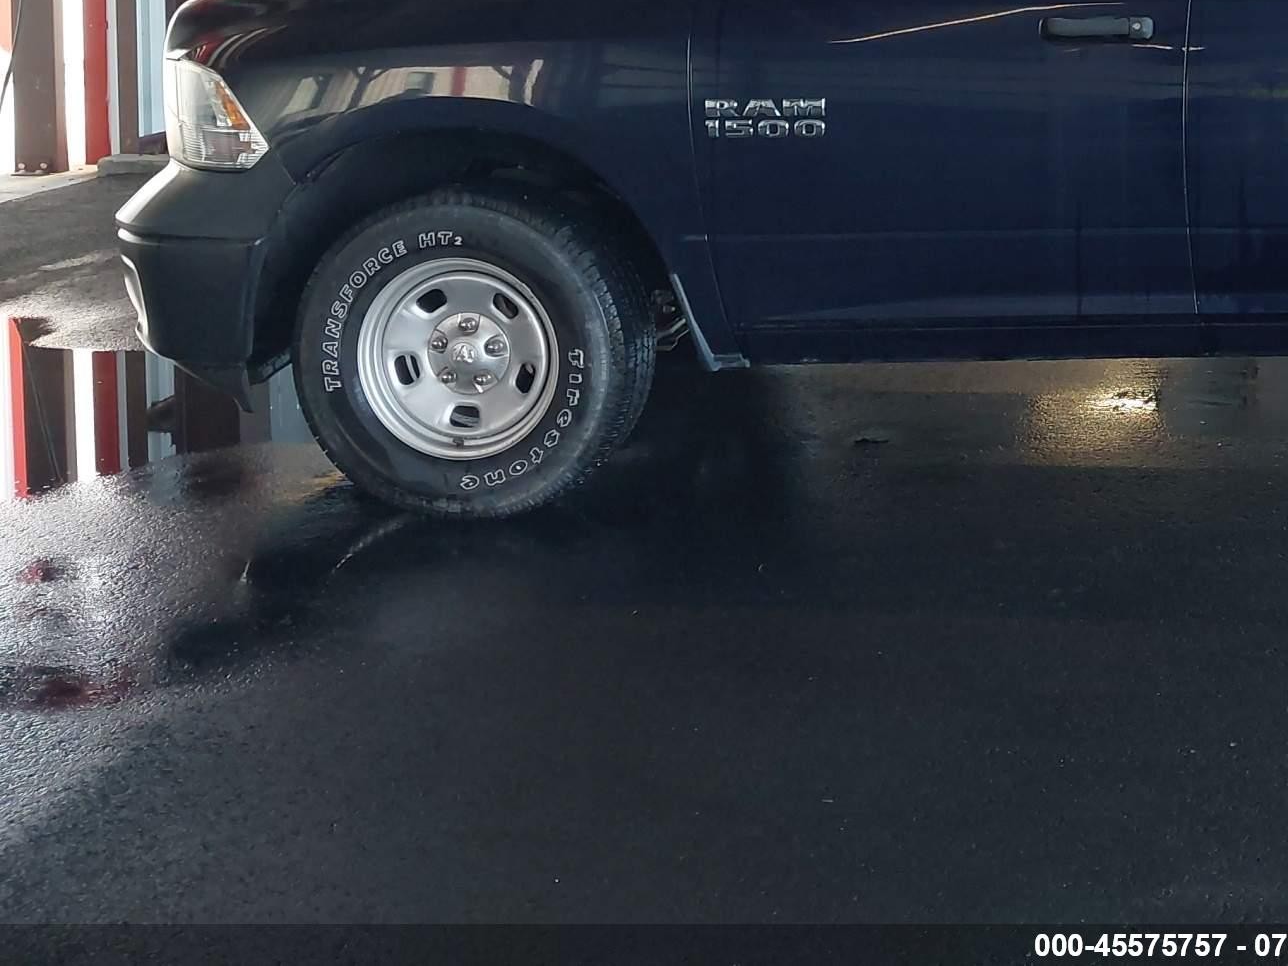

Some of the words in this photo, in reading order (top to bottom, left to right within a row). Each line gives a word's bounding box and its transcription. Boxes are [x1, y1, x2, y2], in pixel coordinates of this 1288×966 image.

[704, 98, 826, 117] RAM
[704, 119, 826, 138] 1500
[322, 240, 408, 392] TRANSFORCE
